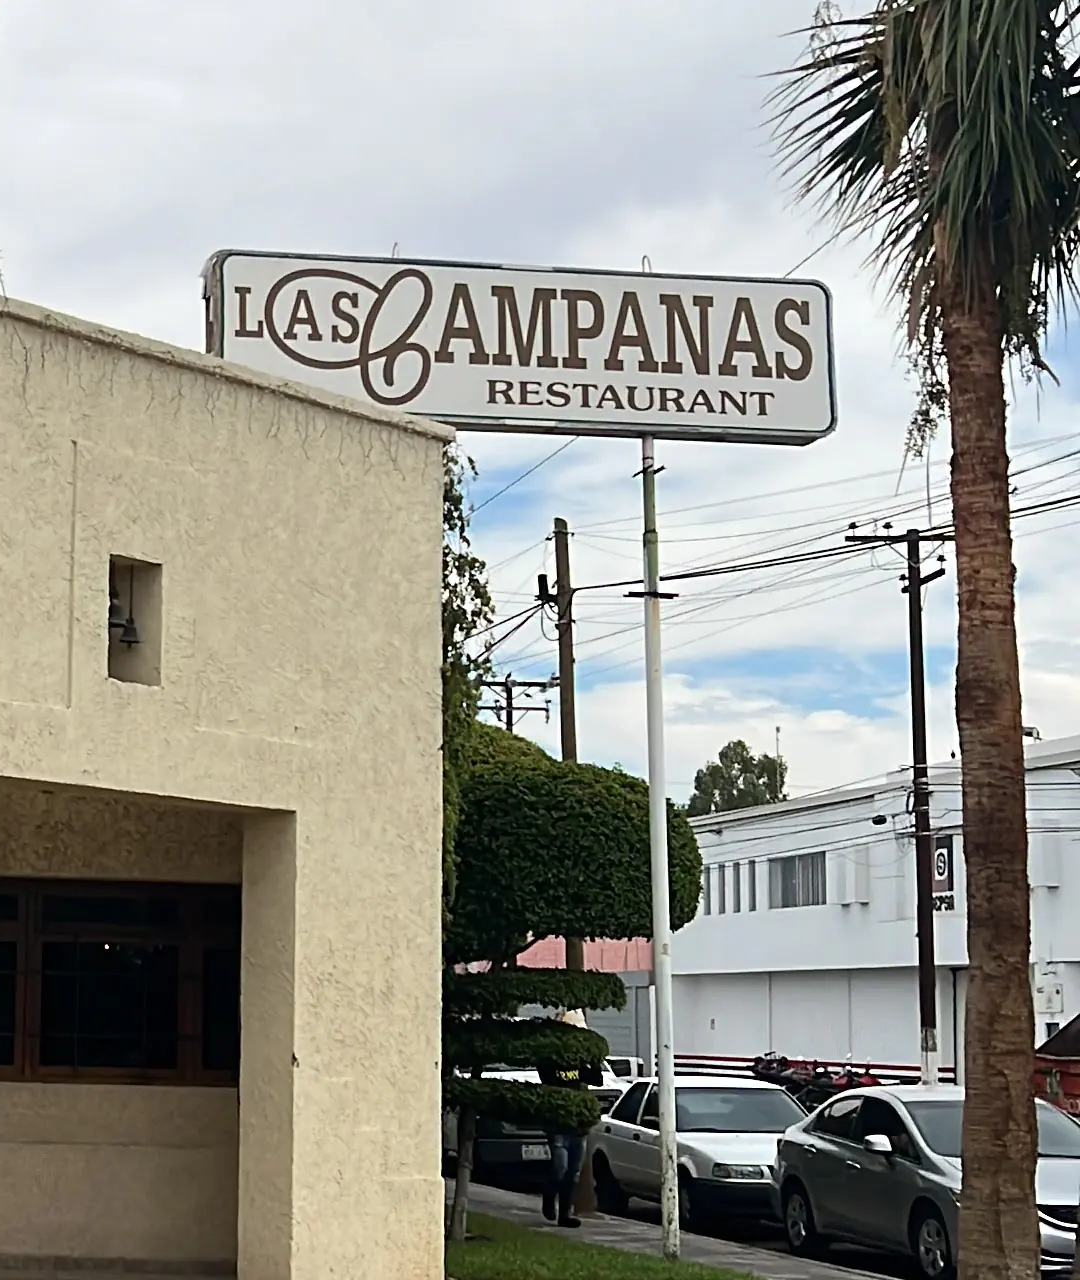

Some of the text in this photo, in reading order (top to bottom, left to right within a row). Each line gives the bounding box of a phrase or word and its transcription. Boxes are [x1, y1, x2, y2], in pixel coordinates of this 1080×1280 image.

[234, 268, 814, 406] LAS CAMPANAS
[486, 379, 776, 417] RESTAURANT
